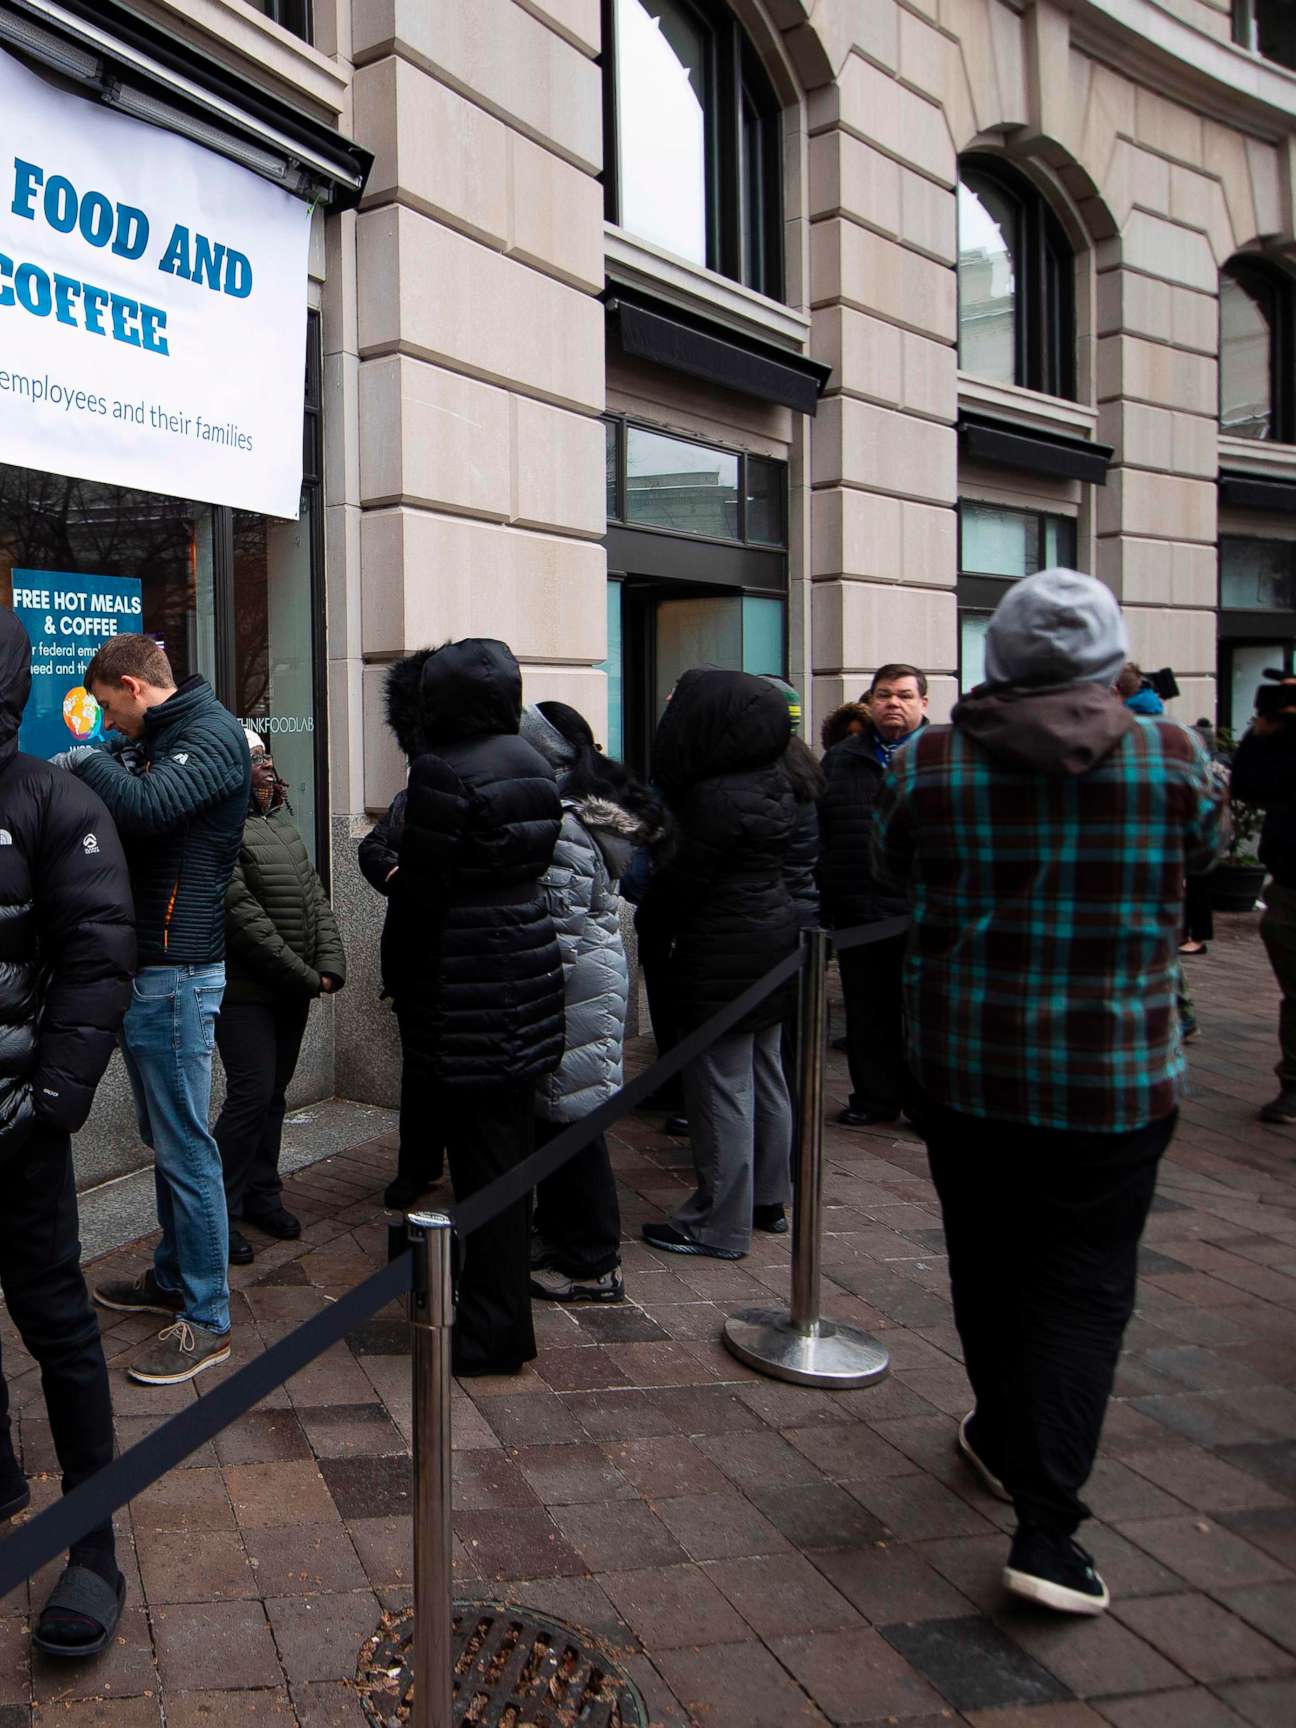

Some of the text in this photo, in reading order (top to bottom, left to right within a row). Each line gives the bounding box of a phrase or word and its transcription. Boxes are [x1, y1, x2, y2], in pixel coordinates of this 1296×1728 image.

[11, 157, 150, 260] FOOD
[158, 223, 253, 298] AND
[112, 401, 145, 425] and
[150, 405, 192, 435] their
[196, 416, 254, 451] families
[13, 589, 142, 614] FREE HOT MEALS
[44, 615, 118, 636] & COFFEE
[39, 641, 75, 657] federal
[56, 660, 75, 675] and
